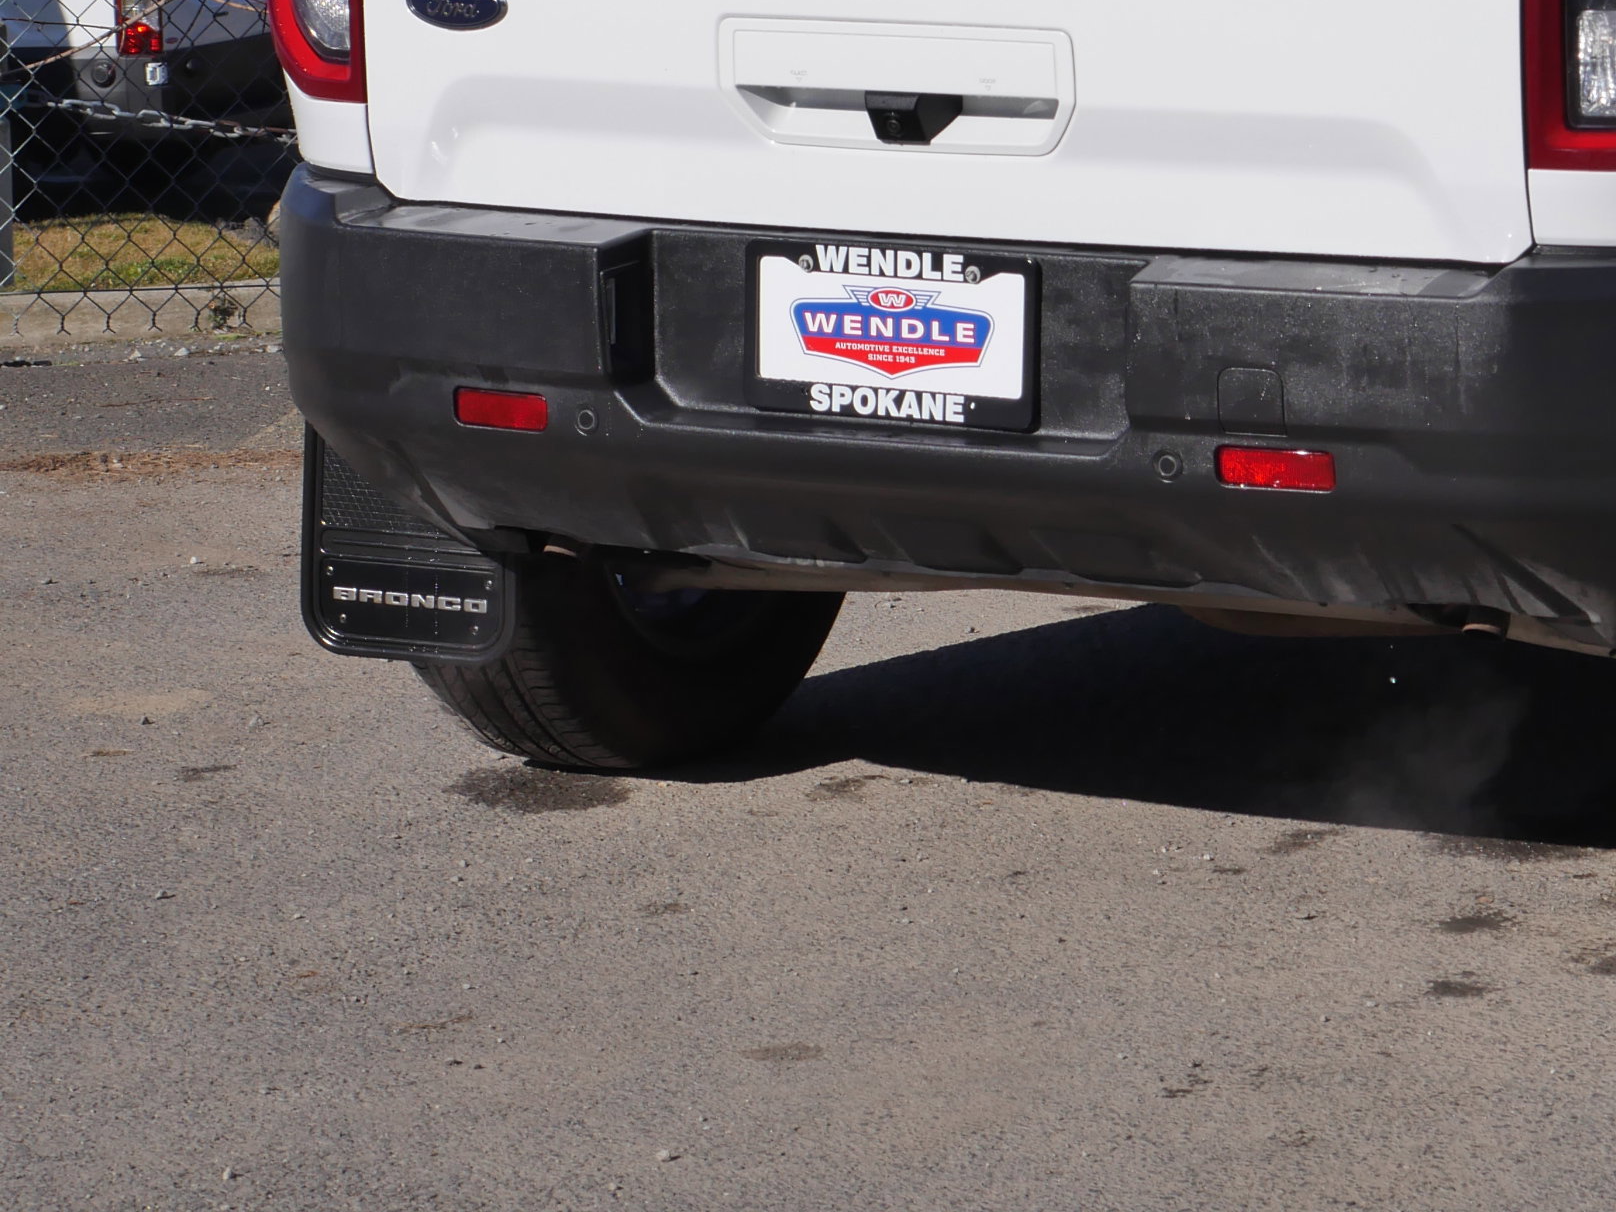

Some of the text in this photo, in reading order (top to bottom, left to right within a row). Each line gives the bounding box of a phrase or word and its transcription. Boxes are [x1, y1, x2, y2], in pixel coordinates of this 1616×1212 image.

[815, 244, 965, 282] WENDLE
[803, 311, 976, 343] WENDLE
[834, 342, 946, 356] AUTOMOTIVE EXCELLENCE
[867, 353, 917, 364] SINCE 1943
[809, 384, 965, 423] SPOKANE
[333, 586, 487, 614] BRONCO
